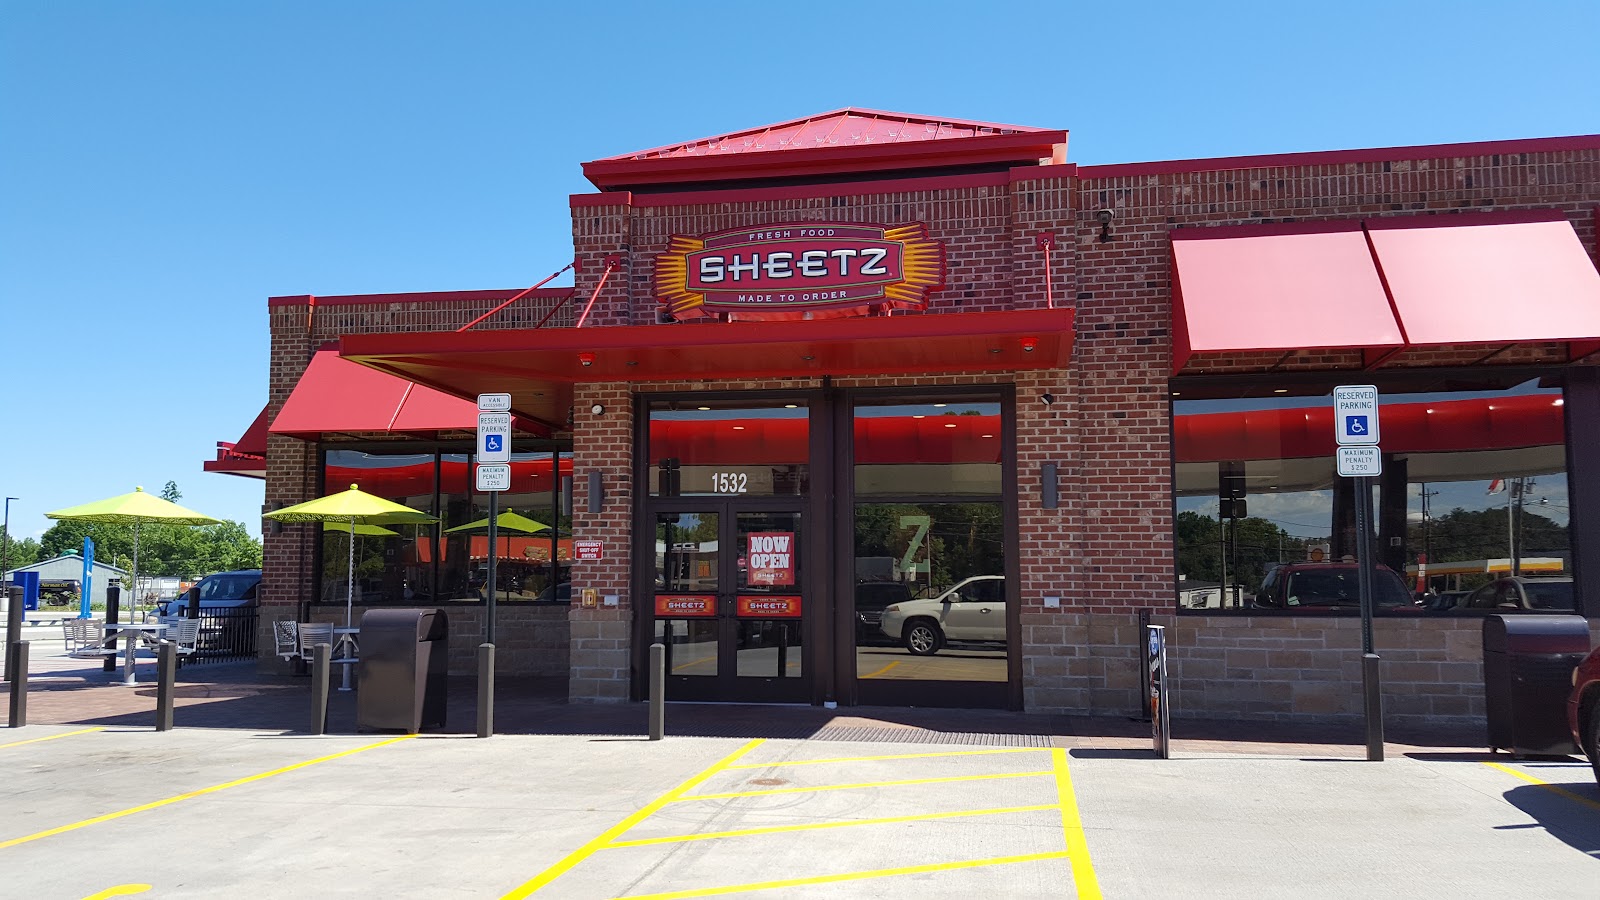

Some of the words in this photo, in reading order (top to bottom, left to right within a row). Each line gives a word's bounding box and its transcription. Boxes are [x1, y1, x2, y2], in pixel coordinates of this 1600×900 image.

[749, 230, 791, 240] FRESH
[800, 229, 835, 238] FOOD
[700, 247, 888, 284] SHEETZ
[738, 294, 772, 302] MADE
[802, 291, 847, 301] ORDER
[1337, 391, 1374, 400] RESERVED
[1340, 401, 1372, 410] PARKING
[711, 472, 748, 493] 1532
[750, 536, 790, 553] NOW
[750, 553, 790, 569] OPEN
